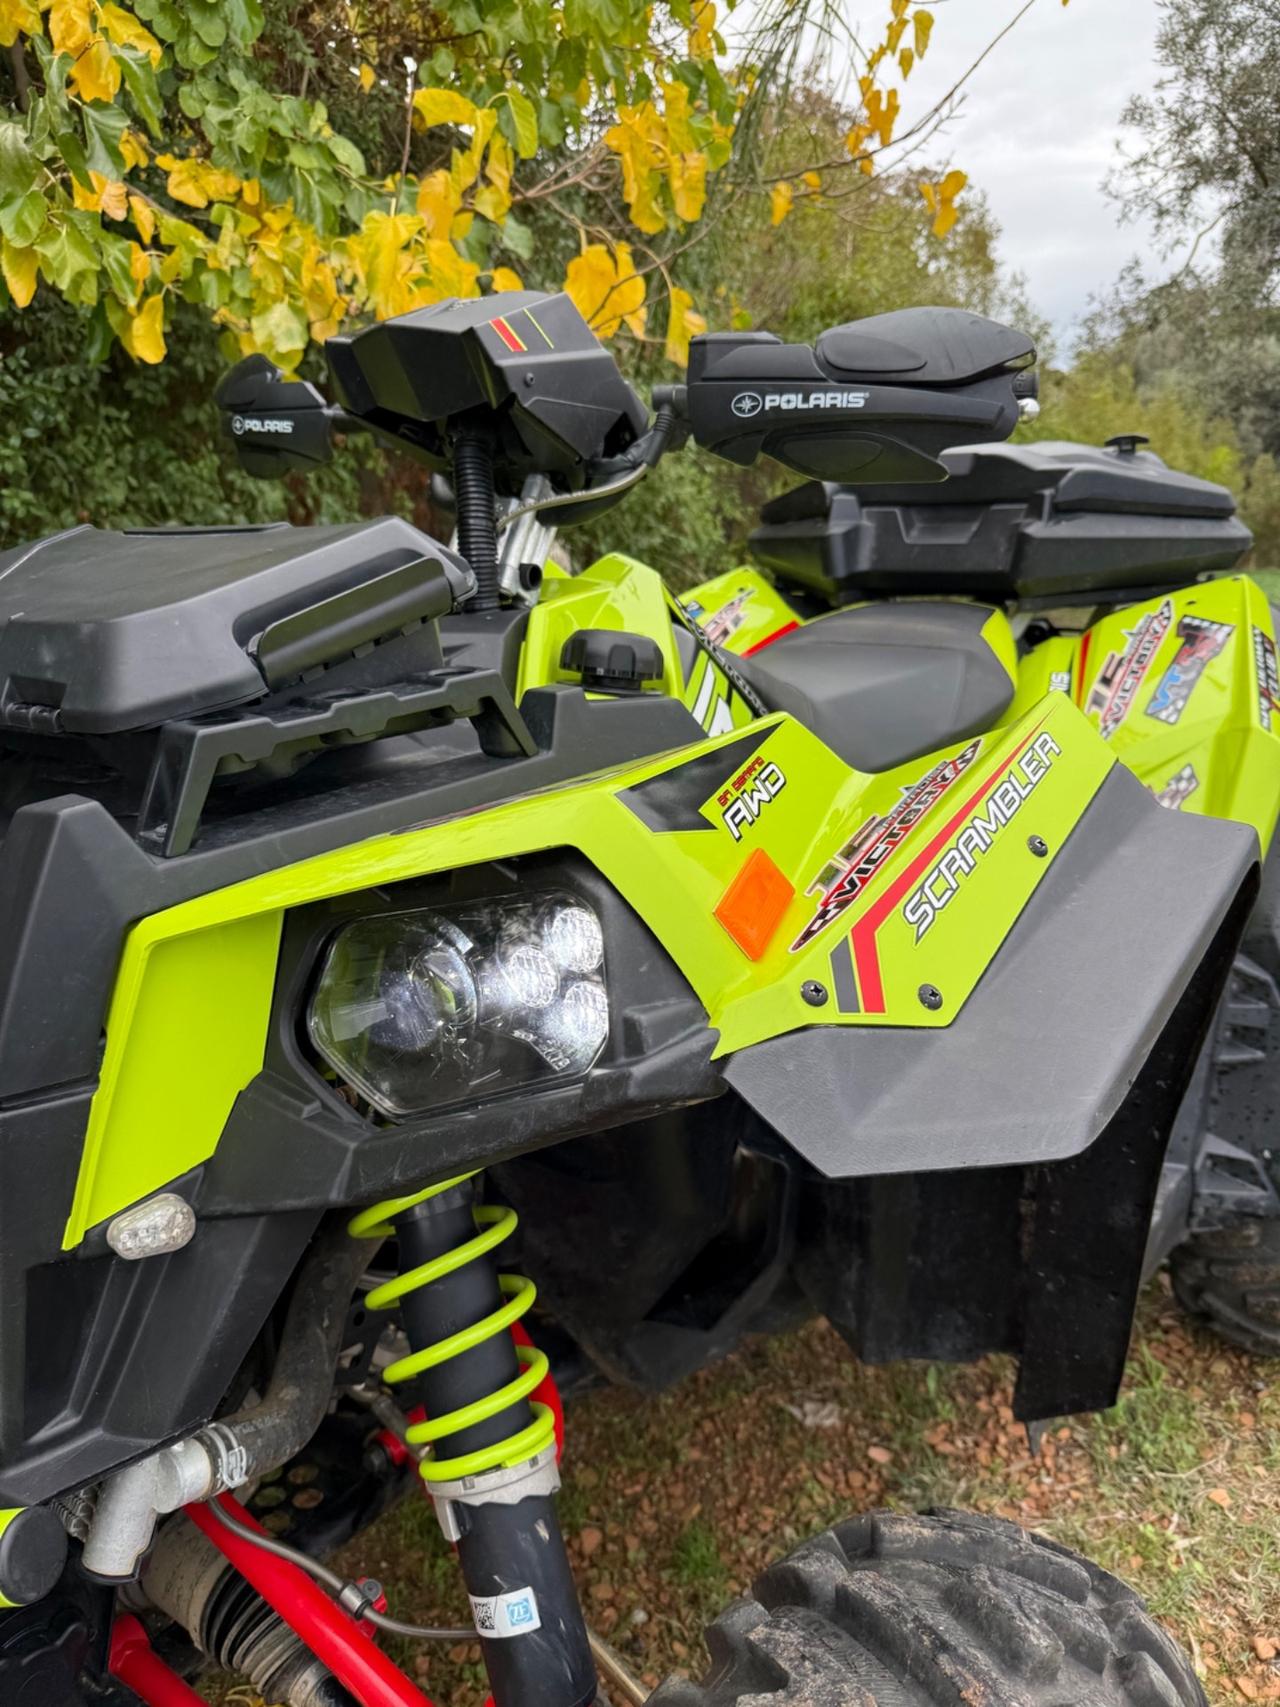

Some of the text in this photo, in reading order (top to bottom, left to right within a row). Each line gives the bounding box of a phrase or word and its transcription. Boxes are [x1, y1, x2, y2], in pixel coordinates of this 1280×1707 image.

[244, 421, 293, 434] POLARIS
[764, 391, 868, 411] POLARIS
[722, 762, 787, 843] AWD
[833, 766, 955, 901] VICTORY
[902, 731, 1062, 947] SCRAMBLER
